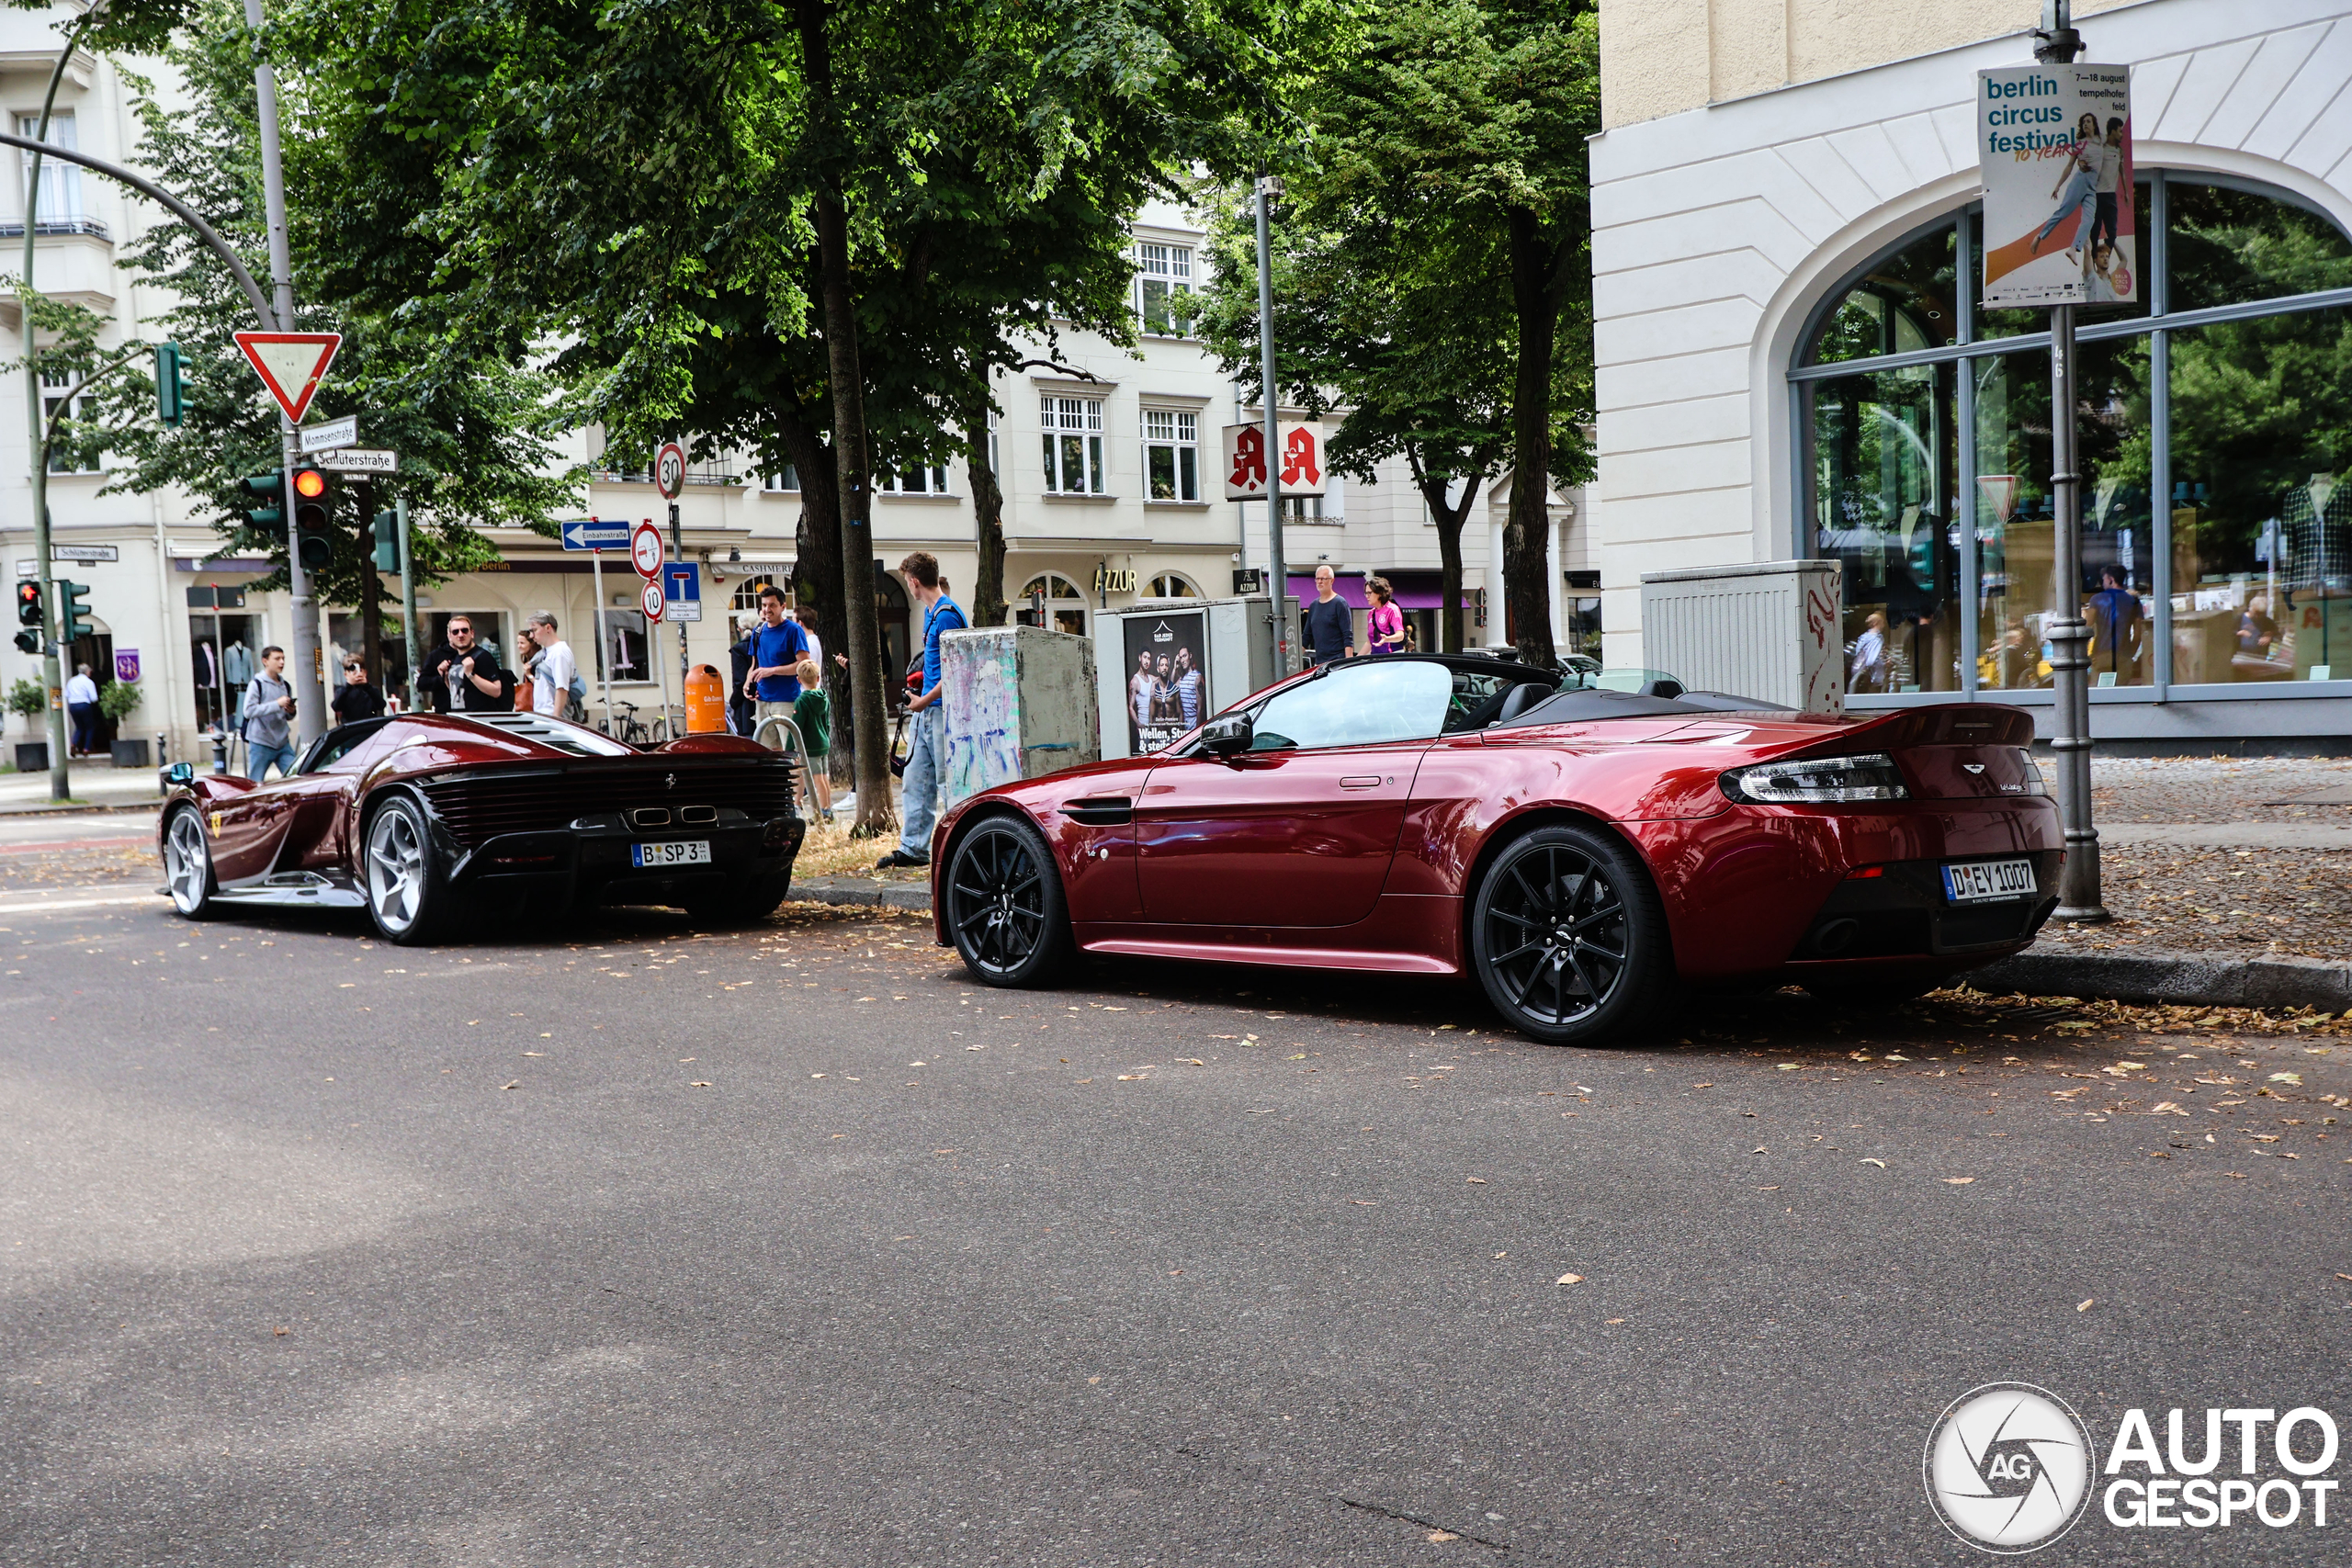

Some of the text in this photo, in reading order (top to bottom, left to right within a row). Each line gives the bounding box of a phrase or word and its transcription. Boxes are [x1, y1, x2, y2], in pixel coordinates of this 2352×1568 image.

[1987, 75, 2057, 99] berlin
[2100, 74, 2125, 85] august
[2079, 88, 2125, 99] tempelhofer
[1988, 104, 2063, 127] circus
[2112, 102, 2126, 111] feld
[1989, 127, 2076, 153] festival
[2015, 140, 2088, 163] 10 YEARS!
[305, 426, 353, 446] Mommsenstraße
[662, 459, 679, 484] 30
[582, 531, 627, 540] Einbahnstraße
[482, 560, 510, 571] Berlin
[1094, 569, 1138, 592] AZZUR
[1240, 583, 1256, 592] AZZUR
[647, 592, 659, 609] 10
[1138, 727, 1170, 741] Wellen,
[1139, 740, 1148, 753] &
[643, 843, 698, 863] B SP 3
[1951, 863, 2031, 896] D EY 1007
